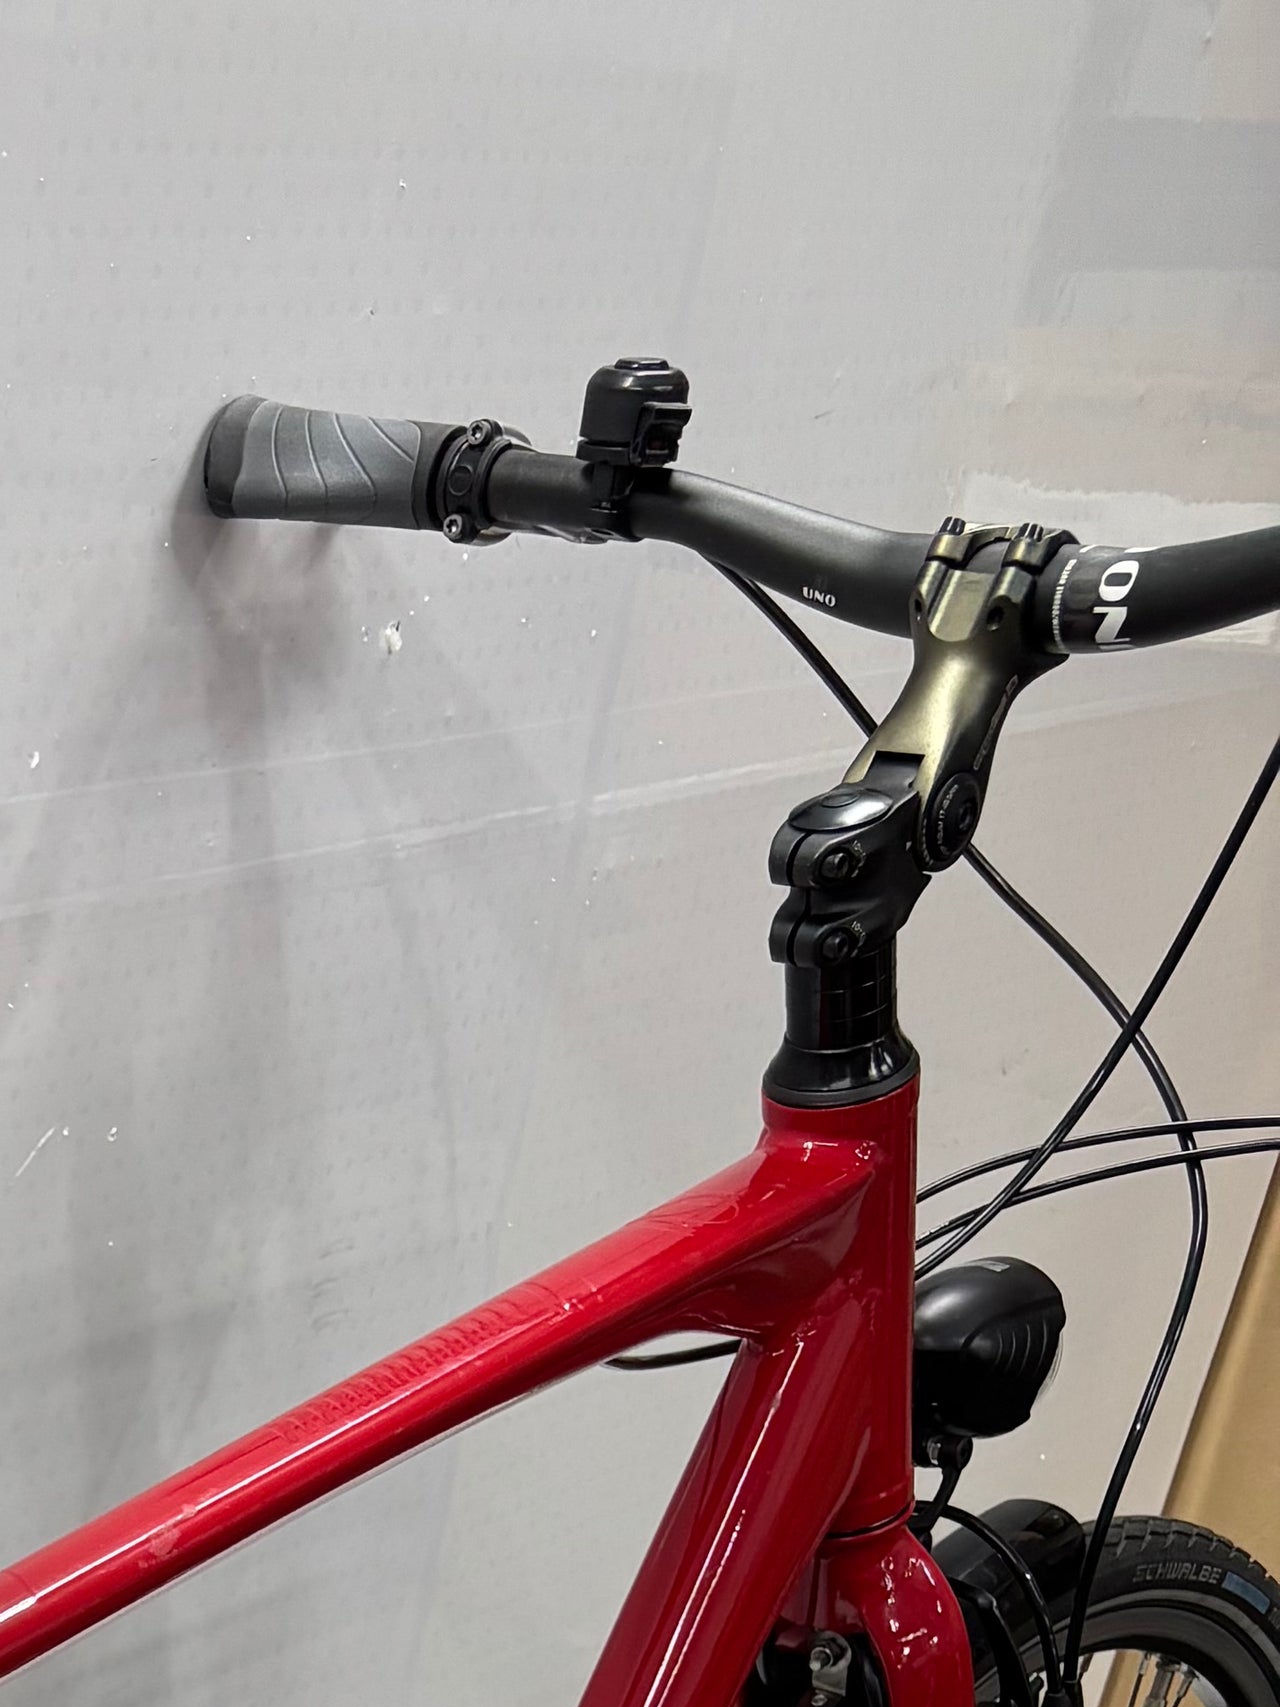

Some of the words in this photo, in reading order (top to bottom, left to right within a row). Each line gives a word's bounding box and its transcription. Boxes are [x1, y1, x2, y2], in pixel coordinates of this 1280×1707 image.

[802, 586, 836, 607] UNO
[1092, 560, 1140, 651] NO
[1132, 1561, 1223, 1585] SCHWALBE
